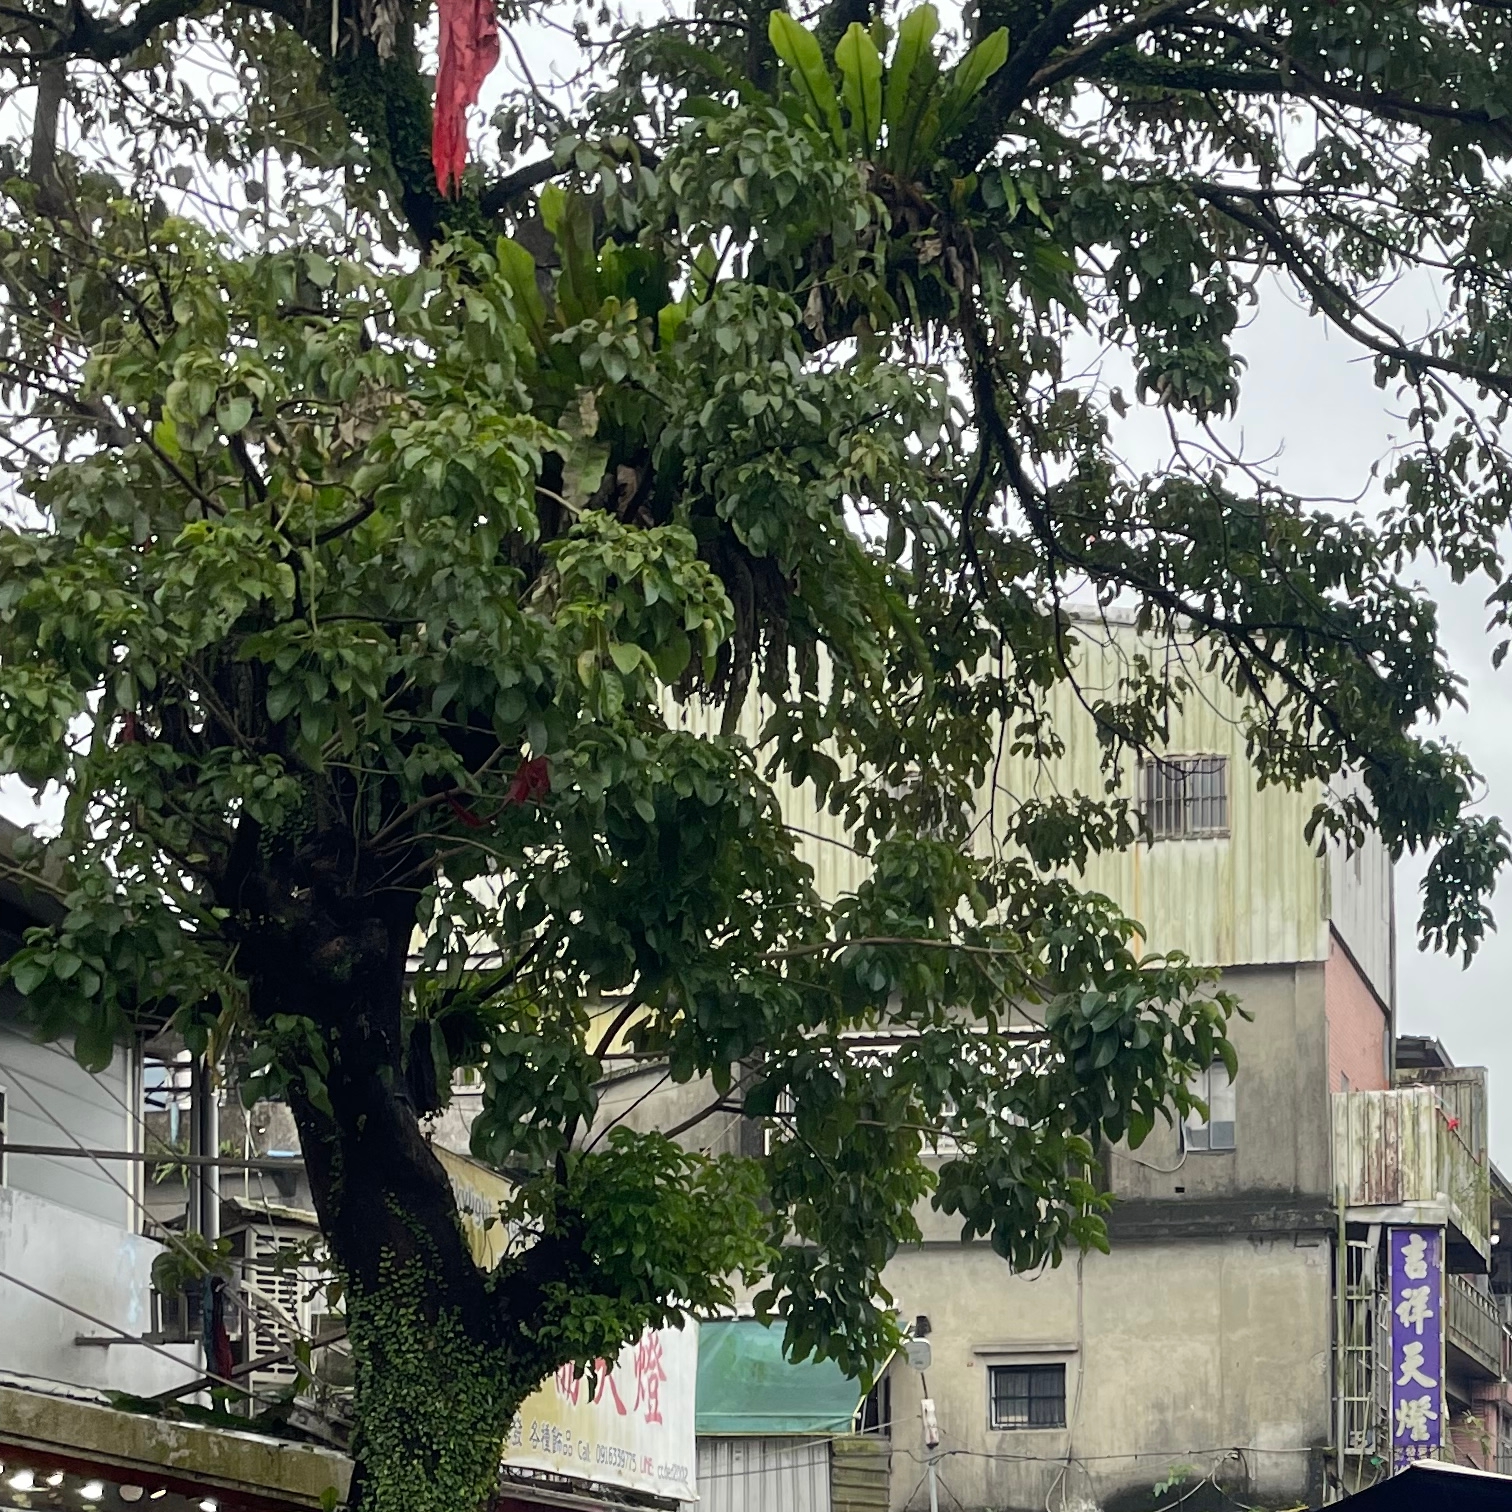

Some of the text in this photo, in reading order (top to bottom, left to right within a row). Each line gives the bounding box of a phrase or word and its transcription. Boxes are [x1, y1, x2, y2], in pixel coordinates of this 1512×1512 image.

[1395, 1233, 1438, 1441] 吉祥天燈
[529, 1420, 573, 1457] 各種飾品
